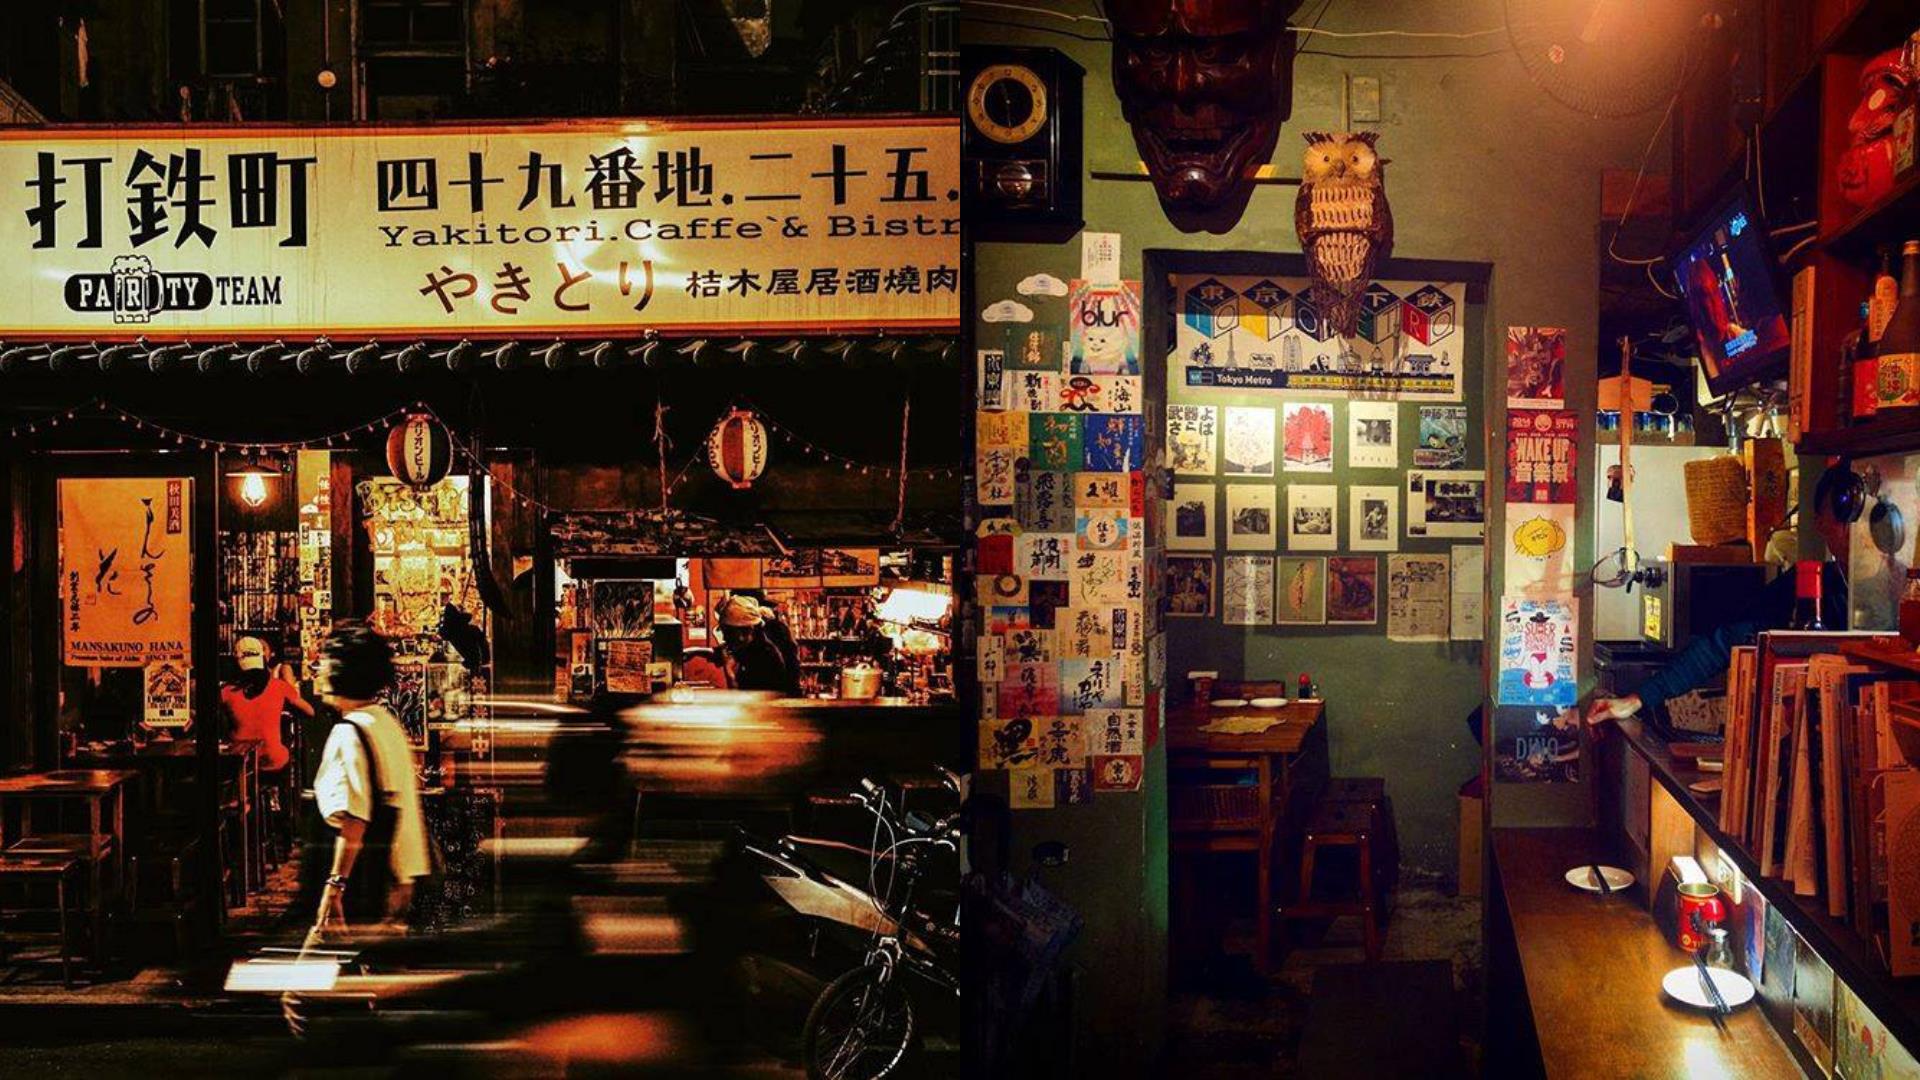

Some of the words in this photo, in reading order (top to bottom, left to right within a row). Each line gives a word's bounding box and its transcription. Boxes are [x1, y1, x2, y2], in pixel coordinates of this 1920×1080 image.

[25, 147, 318, 250] 打鉄町
[216, 275, 282, 306] TEAM
[419, 259, 653, 315] やきとり
[1080, 300, 1129, 328] blur
[1217, 374, 1244, 386] Tokyo
[1245, 375, 1273, 386] Metro
[1515, 437, 1552, 462] WAKE
[1553, 438, 1570, 462] UP
[71, 641, 143, 653] MANSAKUNO
